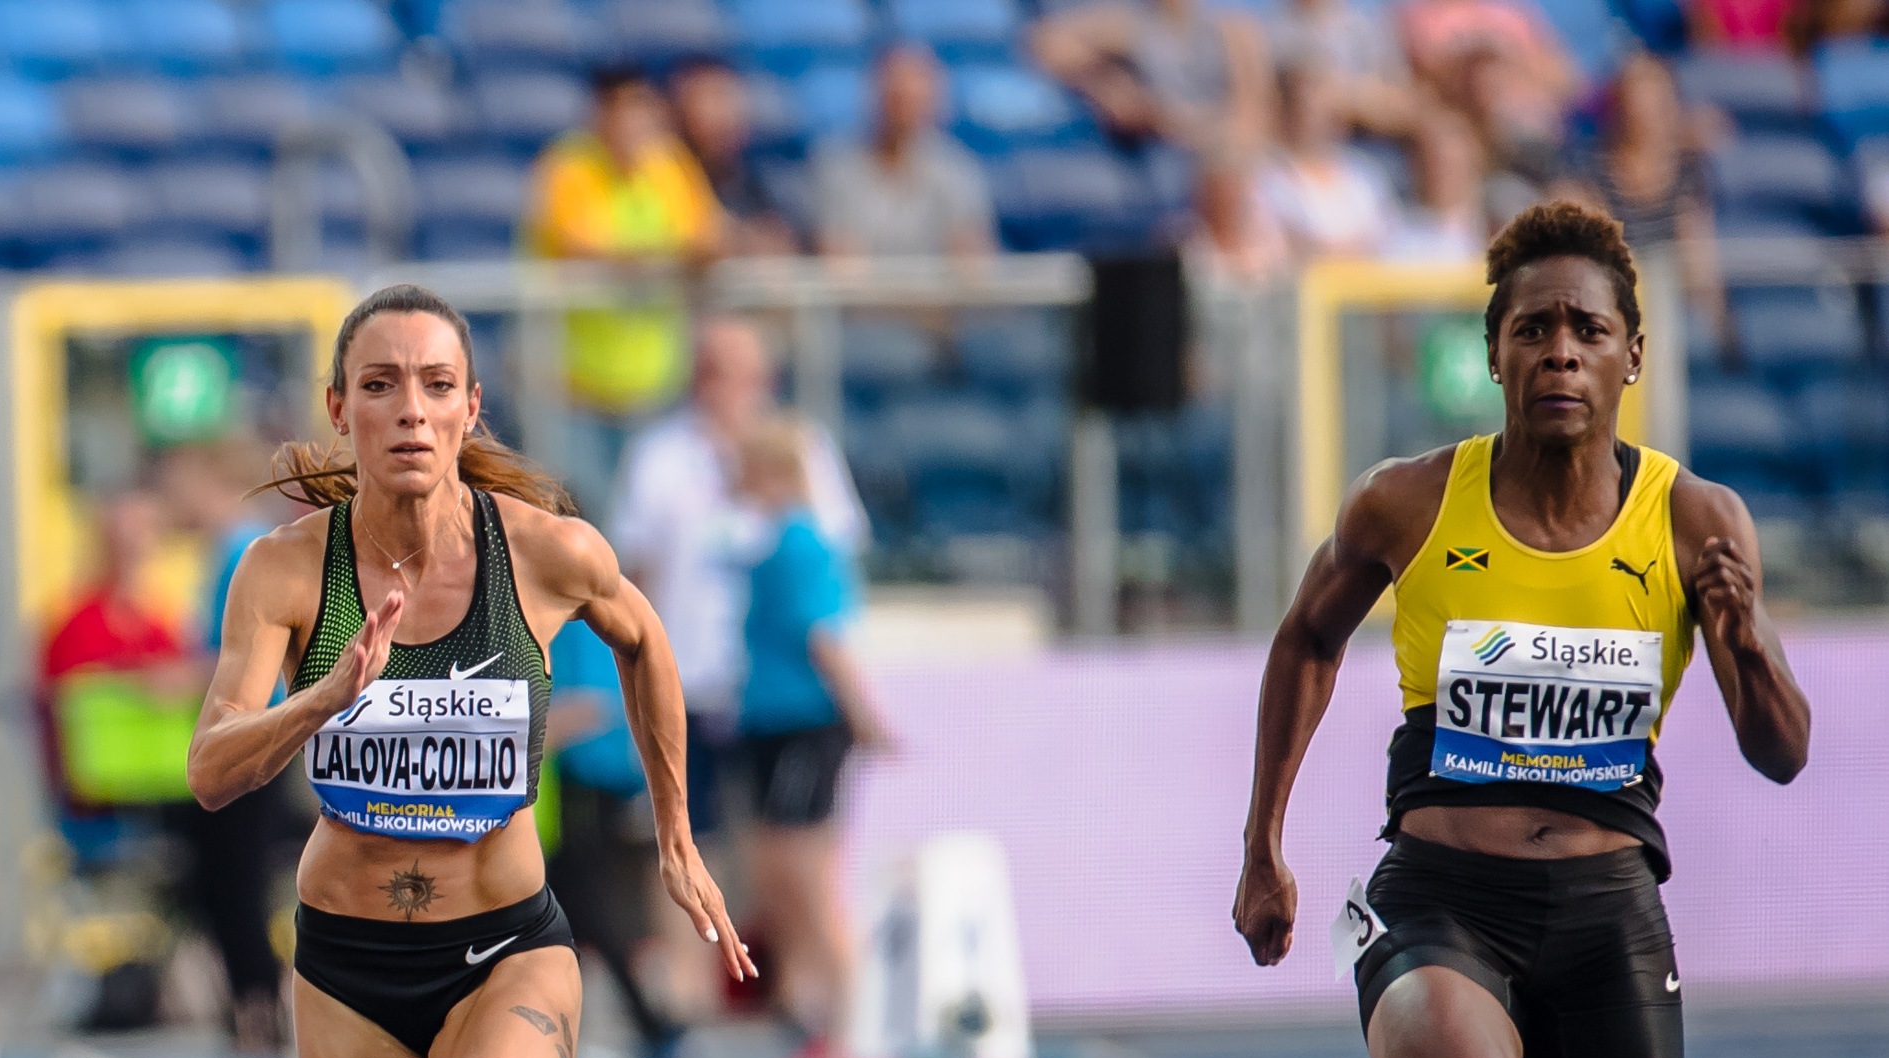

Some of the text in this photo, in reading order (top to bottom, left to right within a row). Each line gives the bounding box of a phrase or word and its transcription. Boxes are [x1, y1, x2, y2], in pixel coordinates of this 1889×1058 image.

[1531, 631, 1639, 669] Śląskie.
[388, 685, 502, 722] Śląskie.
[1446, 678, 1651, 740] STEWART
[312, 734, 517, 790] LALOVA-COLLIO
[1445, 753, 1636, 783] KAMILI SKOLIMOWSKIEJ
[1500, 751, 1587, 769] MEMORIAŁ
[366, 801, 456, 818] MEMORIAŁ
[1346, 899, 1374, 947] 3
